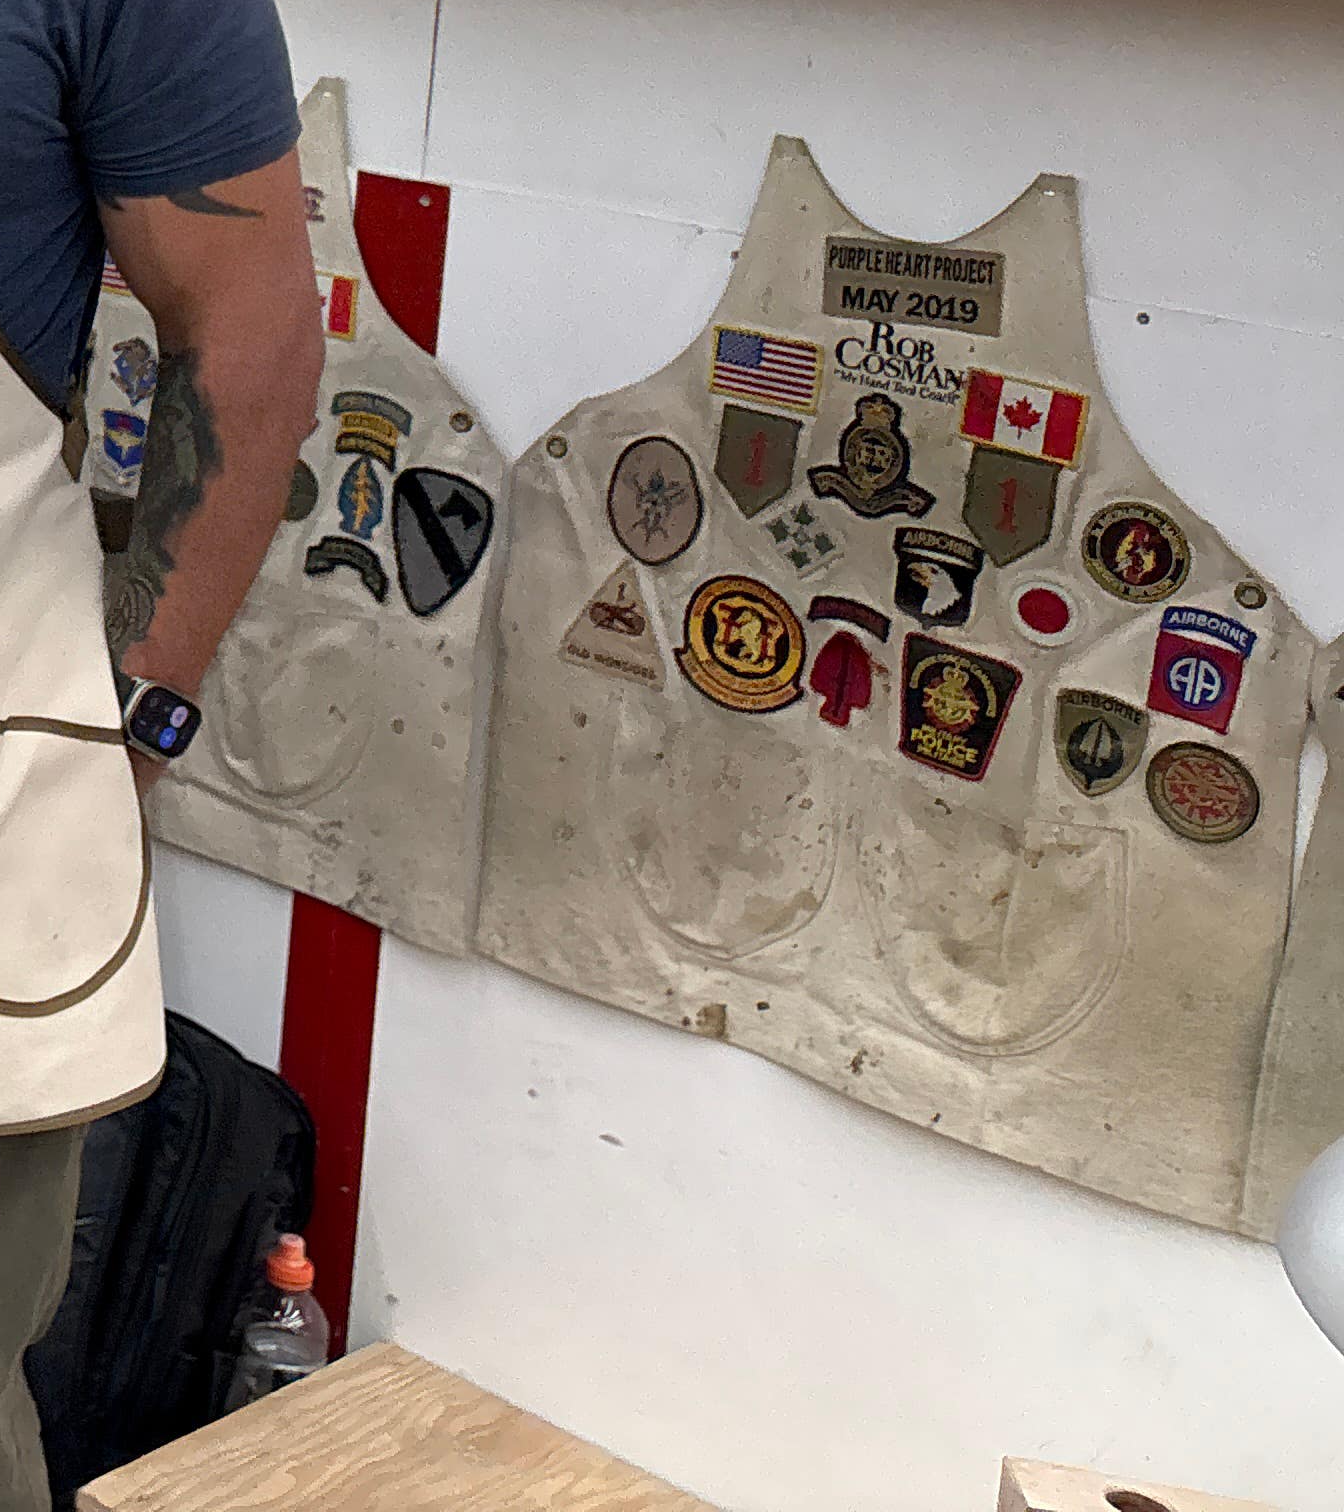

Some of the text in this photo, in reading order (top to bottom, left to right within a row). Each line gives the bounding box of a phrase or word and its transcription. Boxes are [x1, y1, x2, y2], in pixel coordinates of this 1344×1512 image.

[828, 245, 997, 285] PURPLE HEART PROJECT
[841, 285, 980, 324] MAY 2019
[1169, 610, 1249, 649] AIRBORNE
[1169, 657, 1221, 705] AA
[1065, 690, 1143, 726] AIRBORNE
